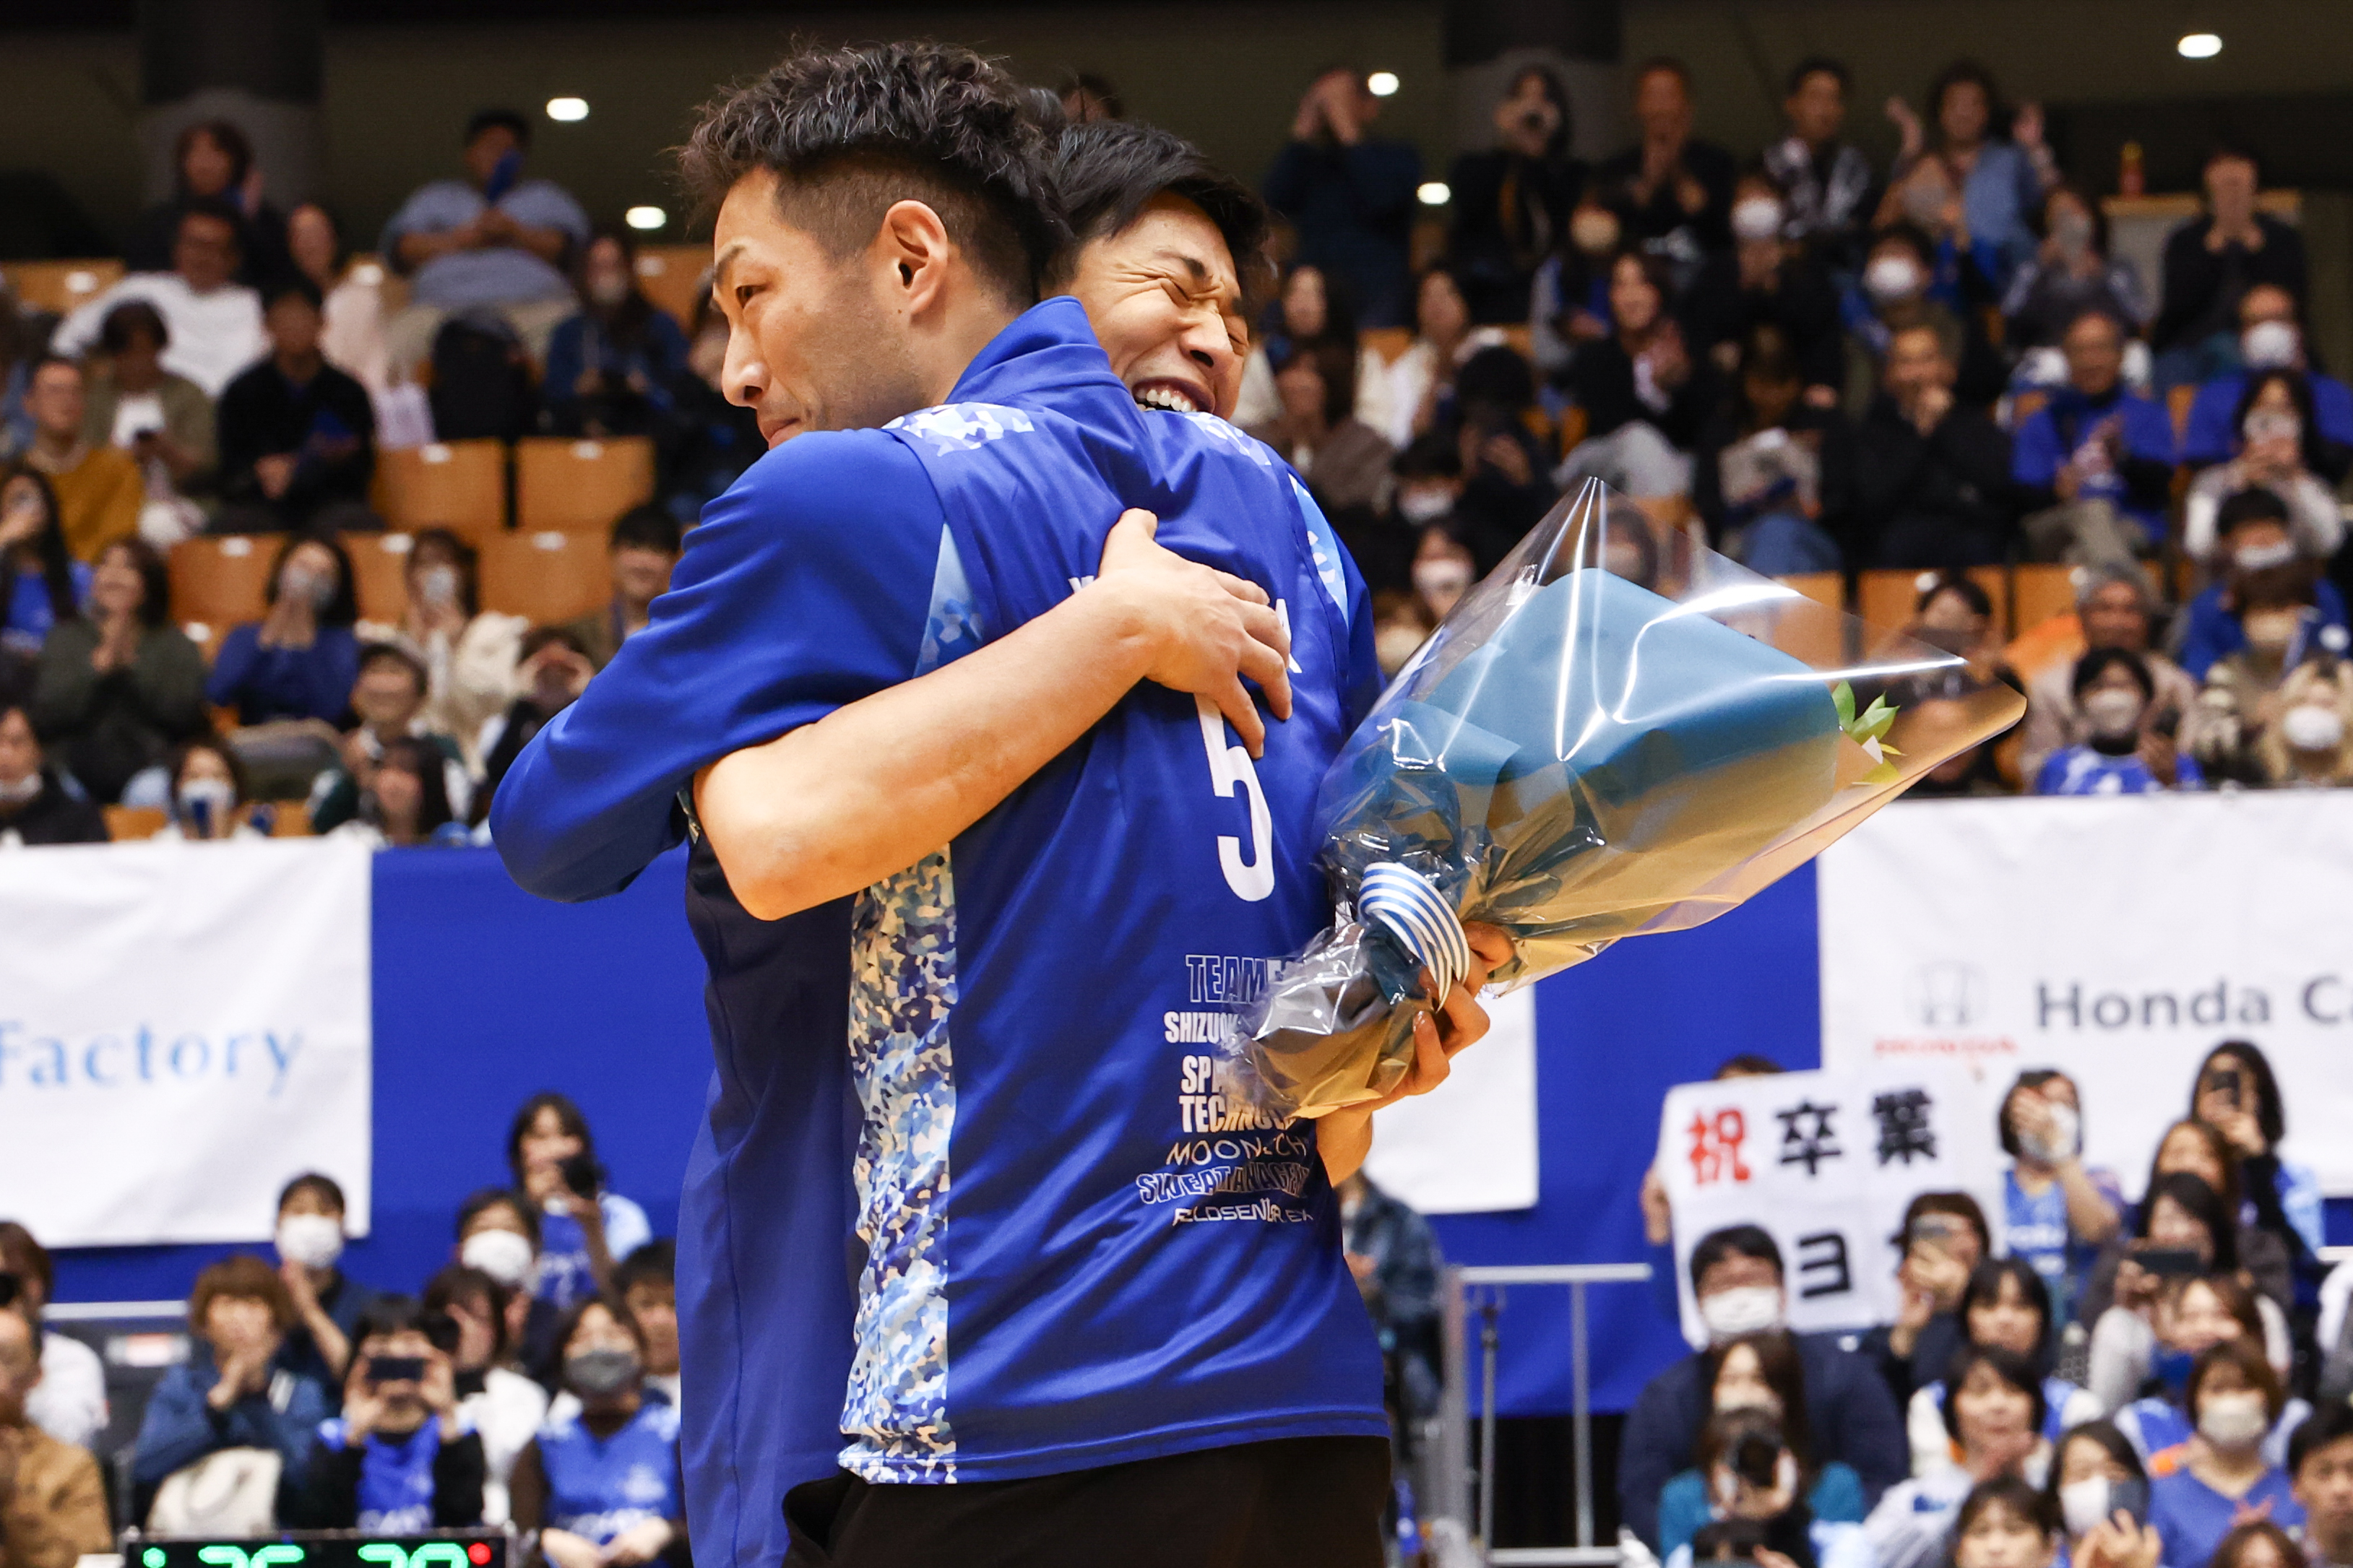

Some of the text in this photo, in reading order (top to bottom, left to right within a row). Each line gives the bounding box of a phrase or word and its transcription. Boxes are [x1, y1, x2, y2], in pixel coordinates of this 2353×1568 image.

[1193, 692, 1275, 903] 5
[2037, 974, 2353, 1030] Honda C
[0, 1019, 302, 1098] Factory
